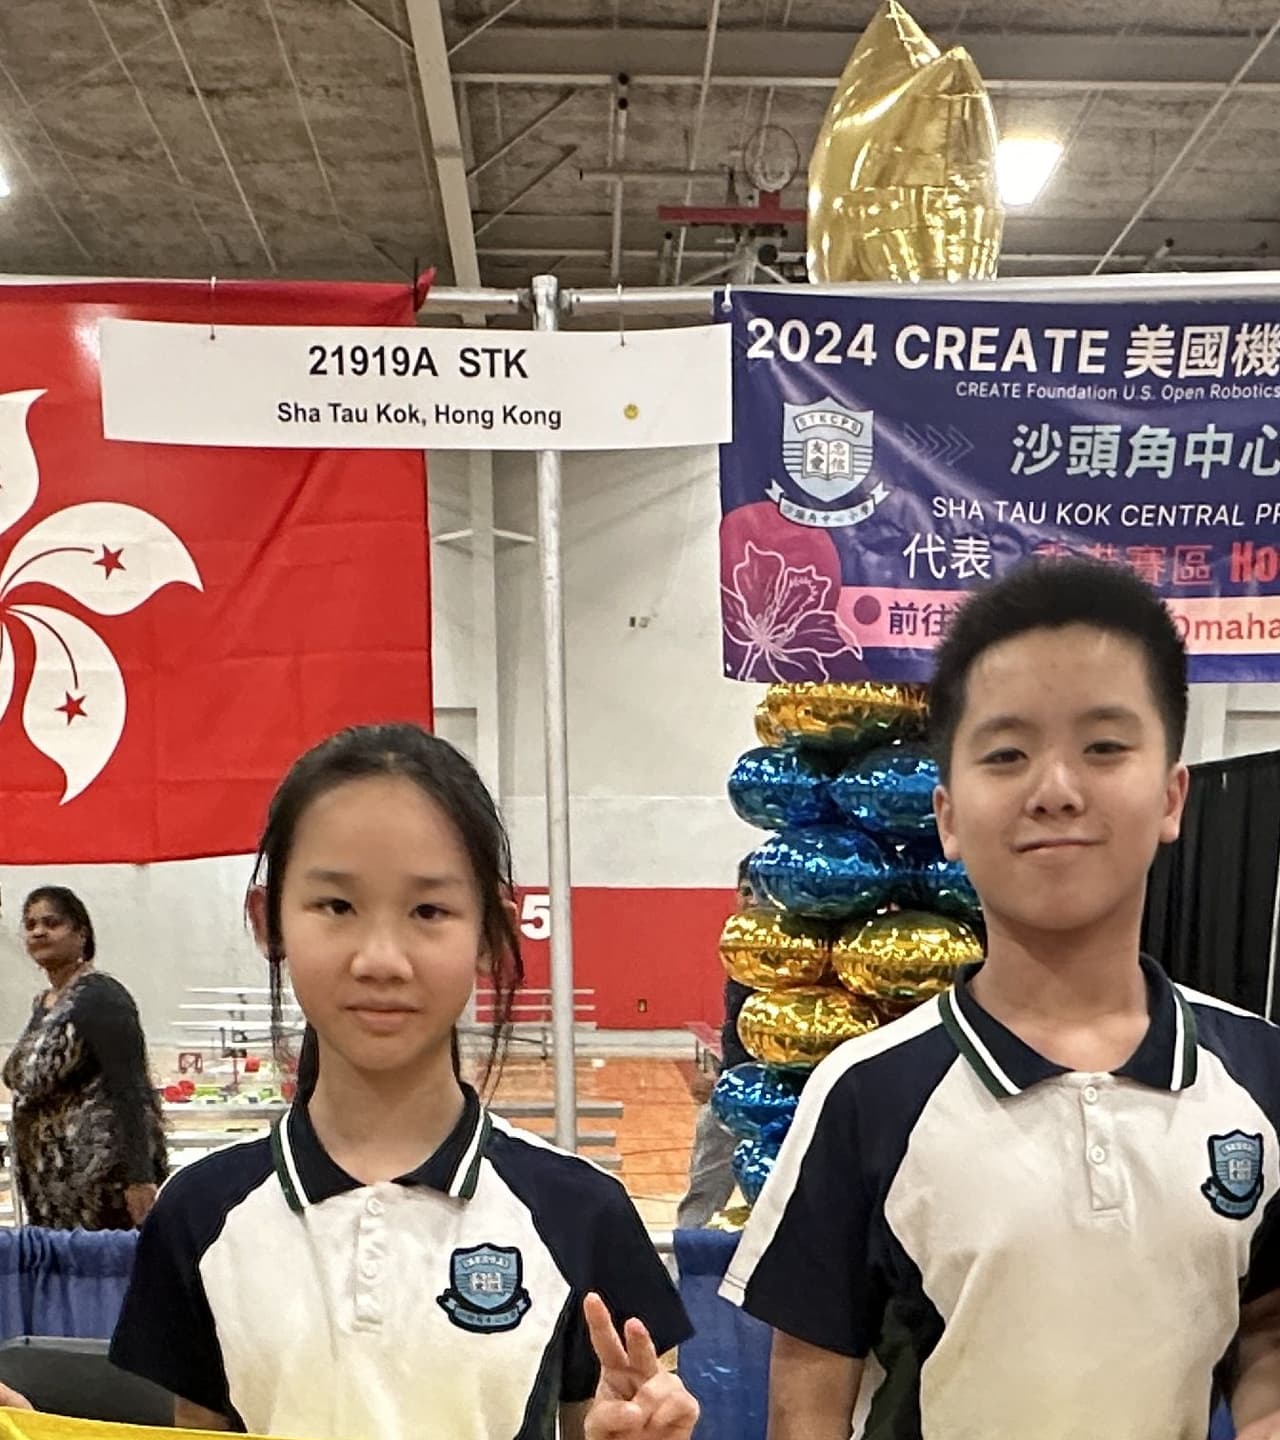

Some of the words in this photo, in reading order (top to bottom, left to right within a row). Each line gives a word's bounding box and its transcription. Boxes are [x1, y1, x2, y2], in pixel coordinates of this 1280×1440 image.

[308, 345, 439, 378] 21919A
[458, 347, 530, 379] STK
[745, 317, 878, 367] 2024
[894, 323, 1110, 374] CREATE
[955, 381, 1022, 399] CREATE
[1026, 382, 1118, 400] Foundation
[1122, 383, 1156, 400] U.S.
[1161, 382, 1205, 403] Open
[277, 402, 321, 424] Sha
[327, 403, 368, 425] Tau
[376, 403, 427, 428] Kok,
[434, 404, 495, 430] Hong
[503, 404, 563, 430] Kong
[932, 496, 985, 520] SHA
[996, 500, 1047, 523] TAU
[1055, 503, 1111, 526] KOK
[1120, 504, 1245, 528] CENTRAL
[902, 532, 993, 580] 代表
[1030, 543, 1214, 586] 賽區
[888, 602, 961, 636] 前往
